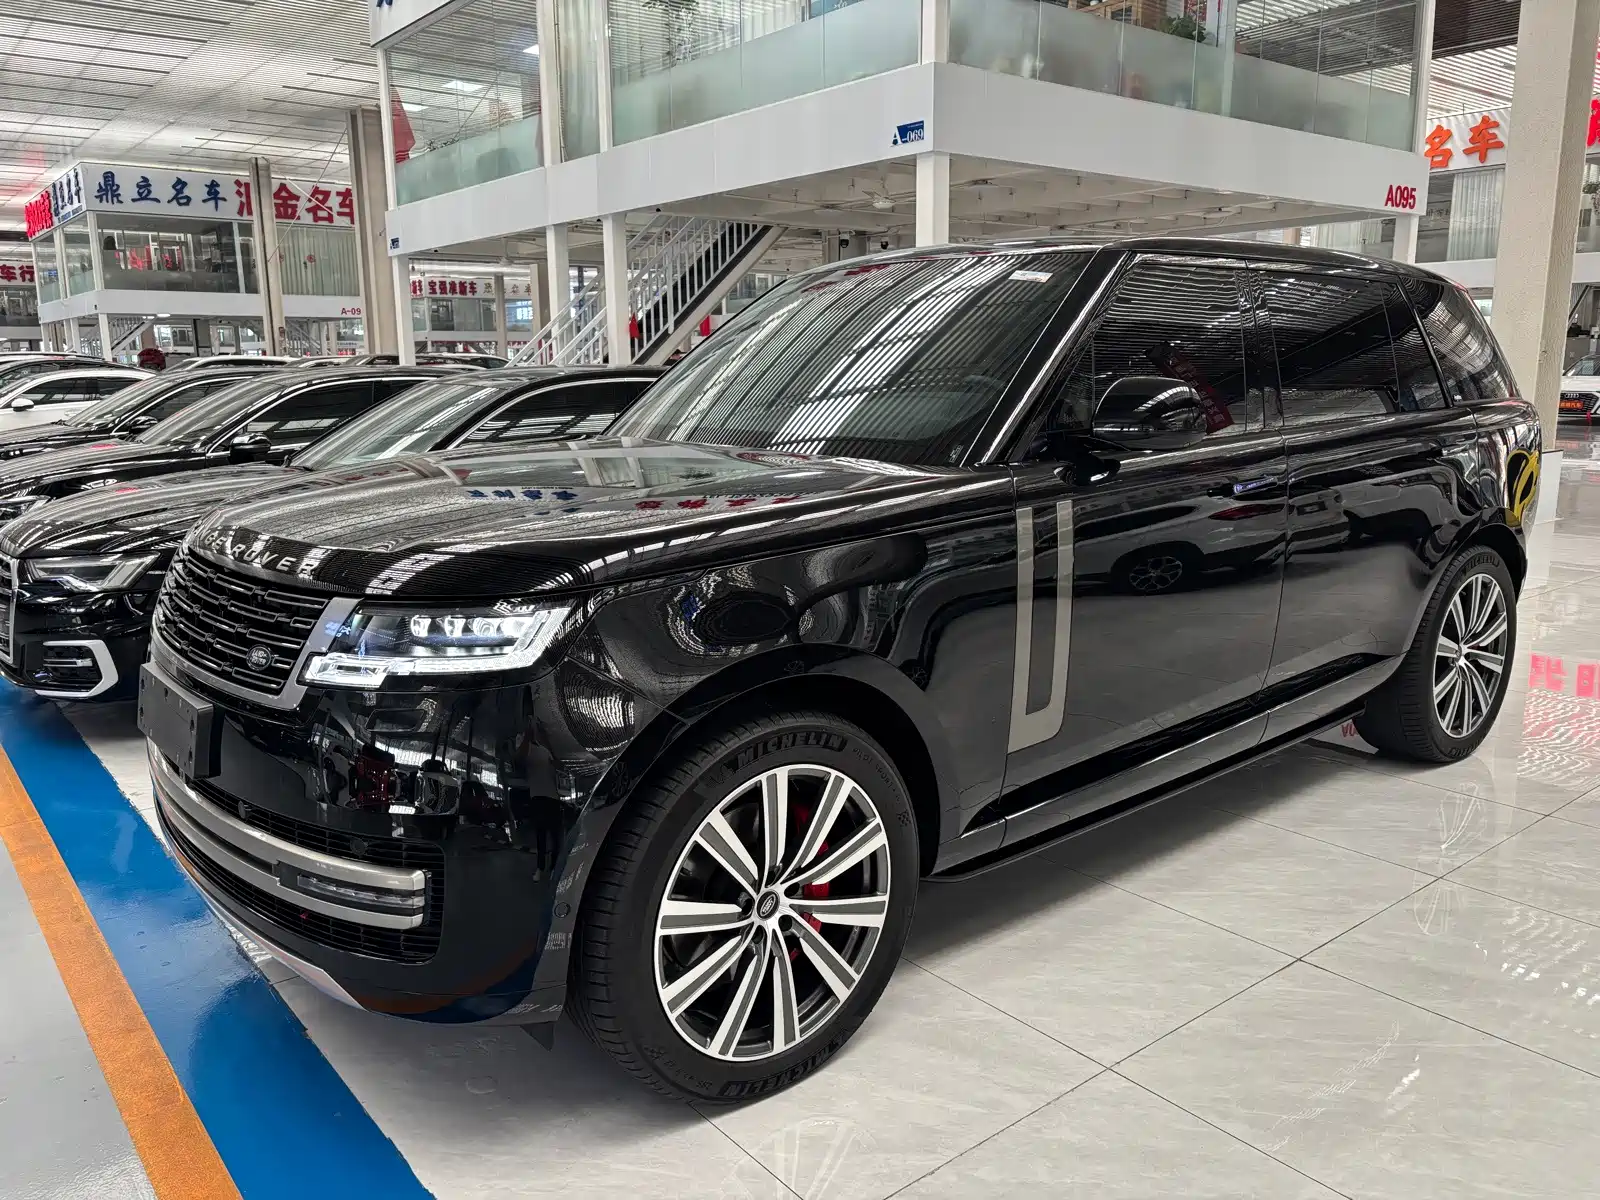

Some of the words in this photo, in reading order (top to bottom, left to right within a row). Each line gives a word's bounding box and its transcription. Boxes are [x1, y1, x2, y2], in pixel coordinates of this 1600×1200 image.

[1424, 115, 1505, 171] 名车
[94, 170, 228, 212] 鼎立名车
[1384, 184, 1417, 210] A095
[231, 543, 316, 576] ROVER
[736, 731, 847, 770] MICHELIN
